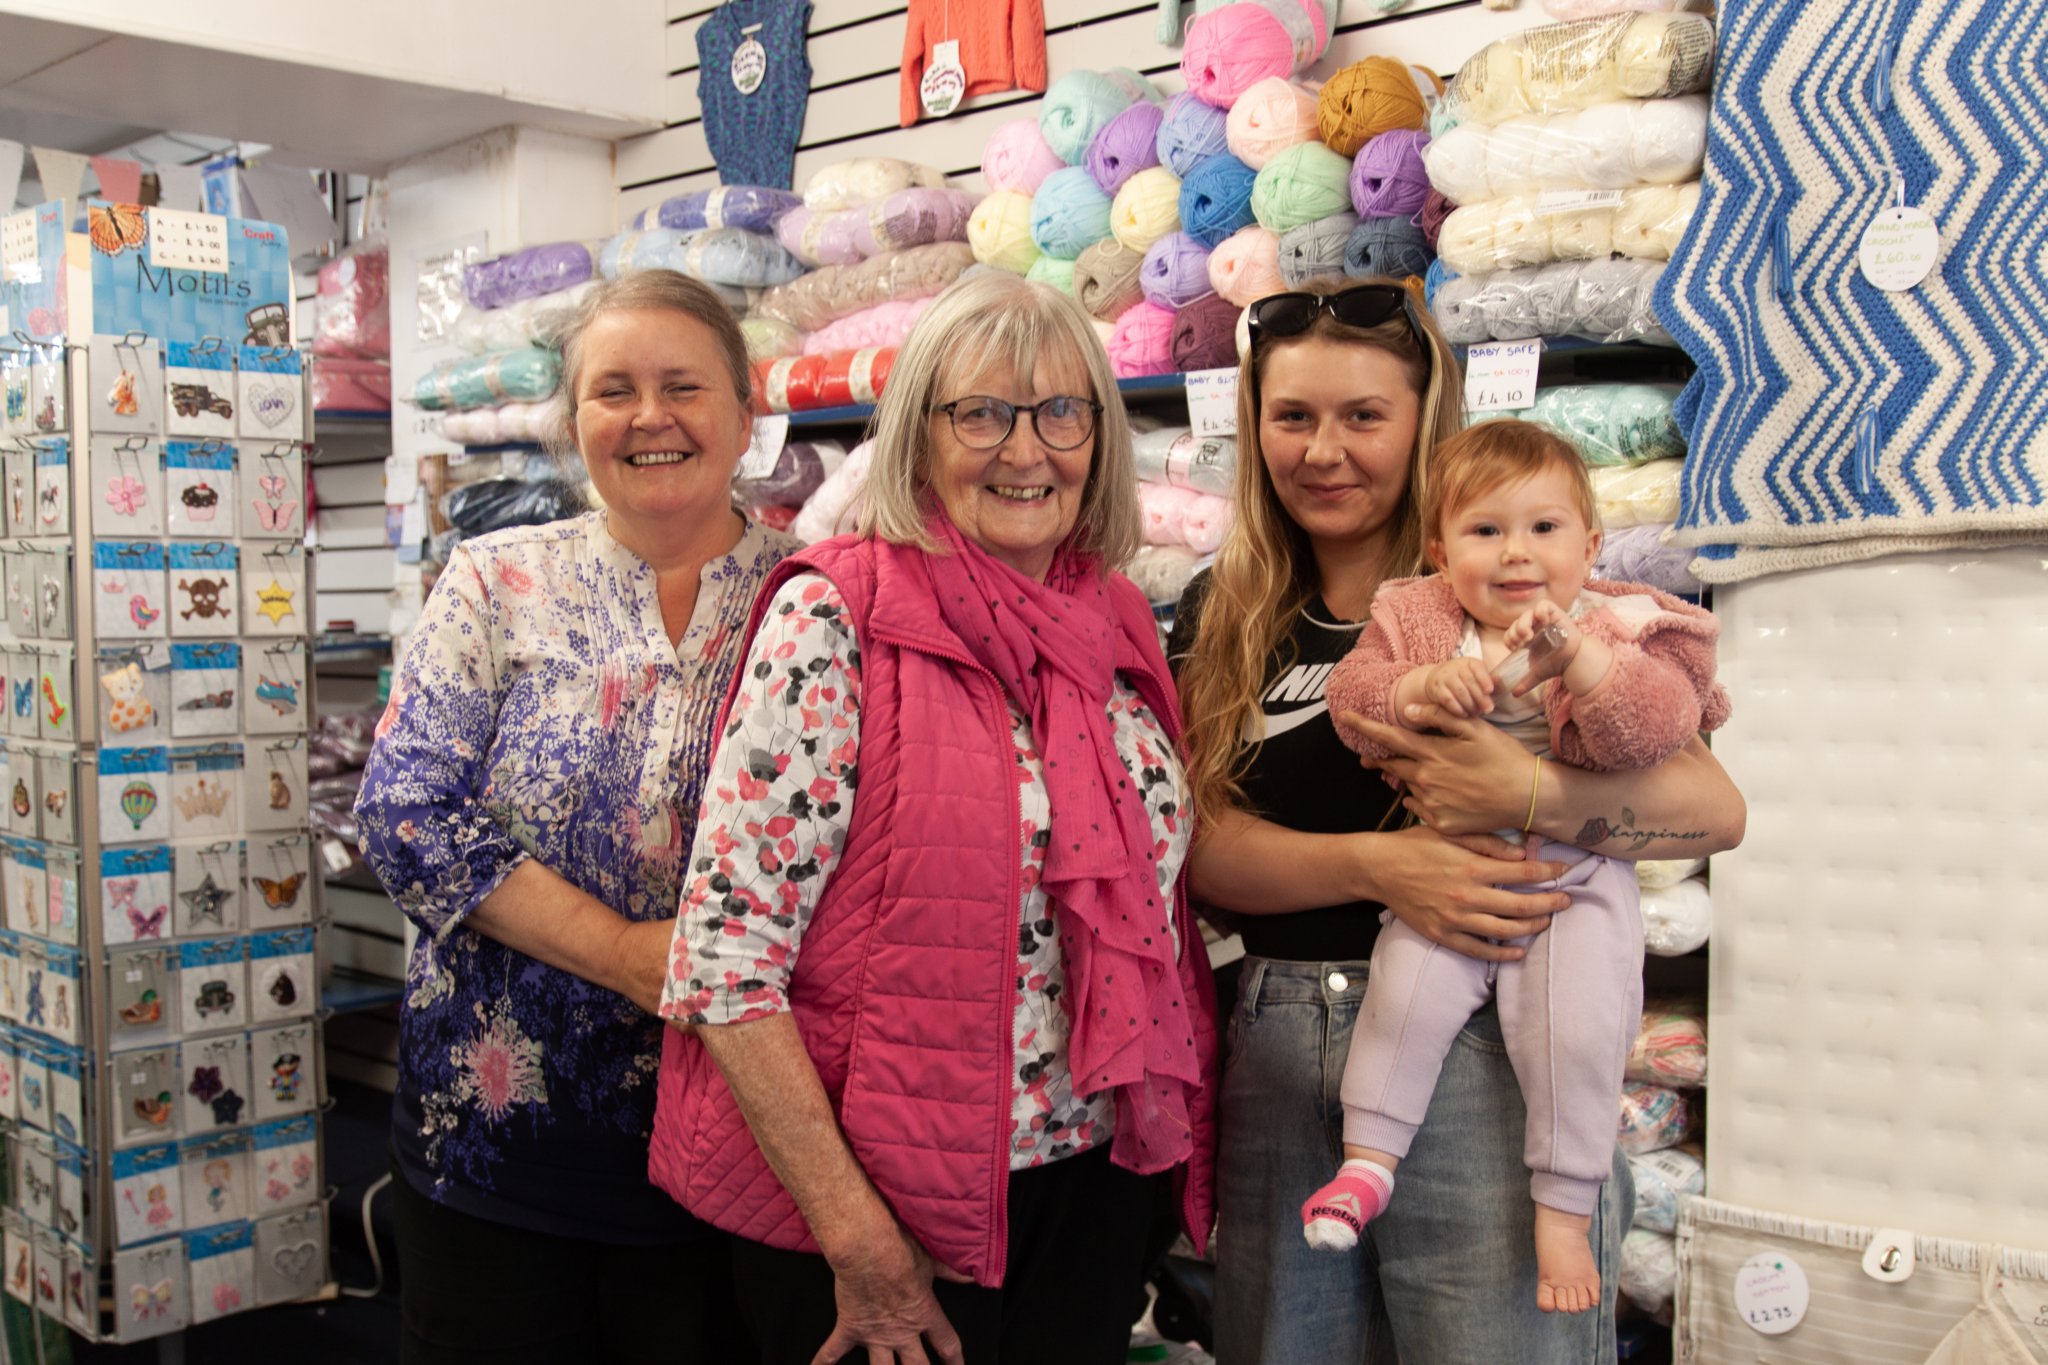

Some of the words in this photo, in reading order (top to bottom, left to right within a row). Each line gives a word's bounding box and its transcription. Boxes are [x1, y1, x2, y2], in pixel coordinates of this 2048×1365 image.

[244, 227, 275, 241] Craft
[1470, 346, 1501, 358] BABY
[1507, 344, 1536, 357] SAFE
[1608, 824, 1709, 842] happiness
